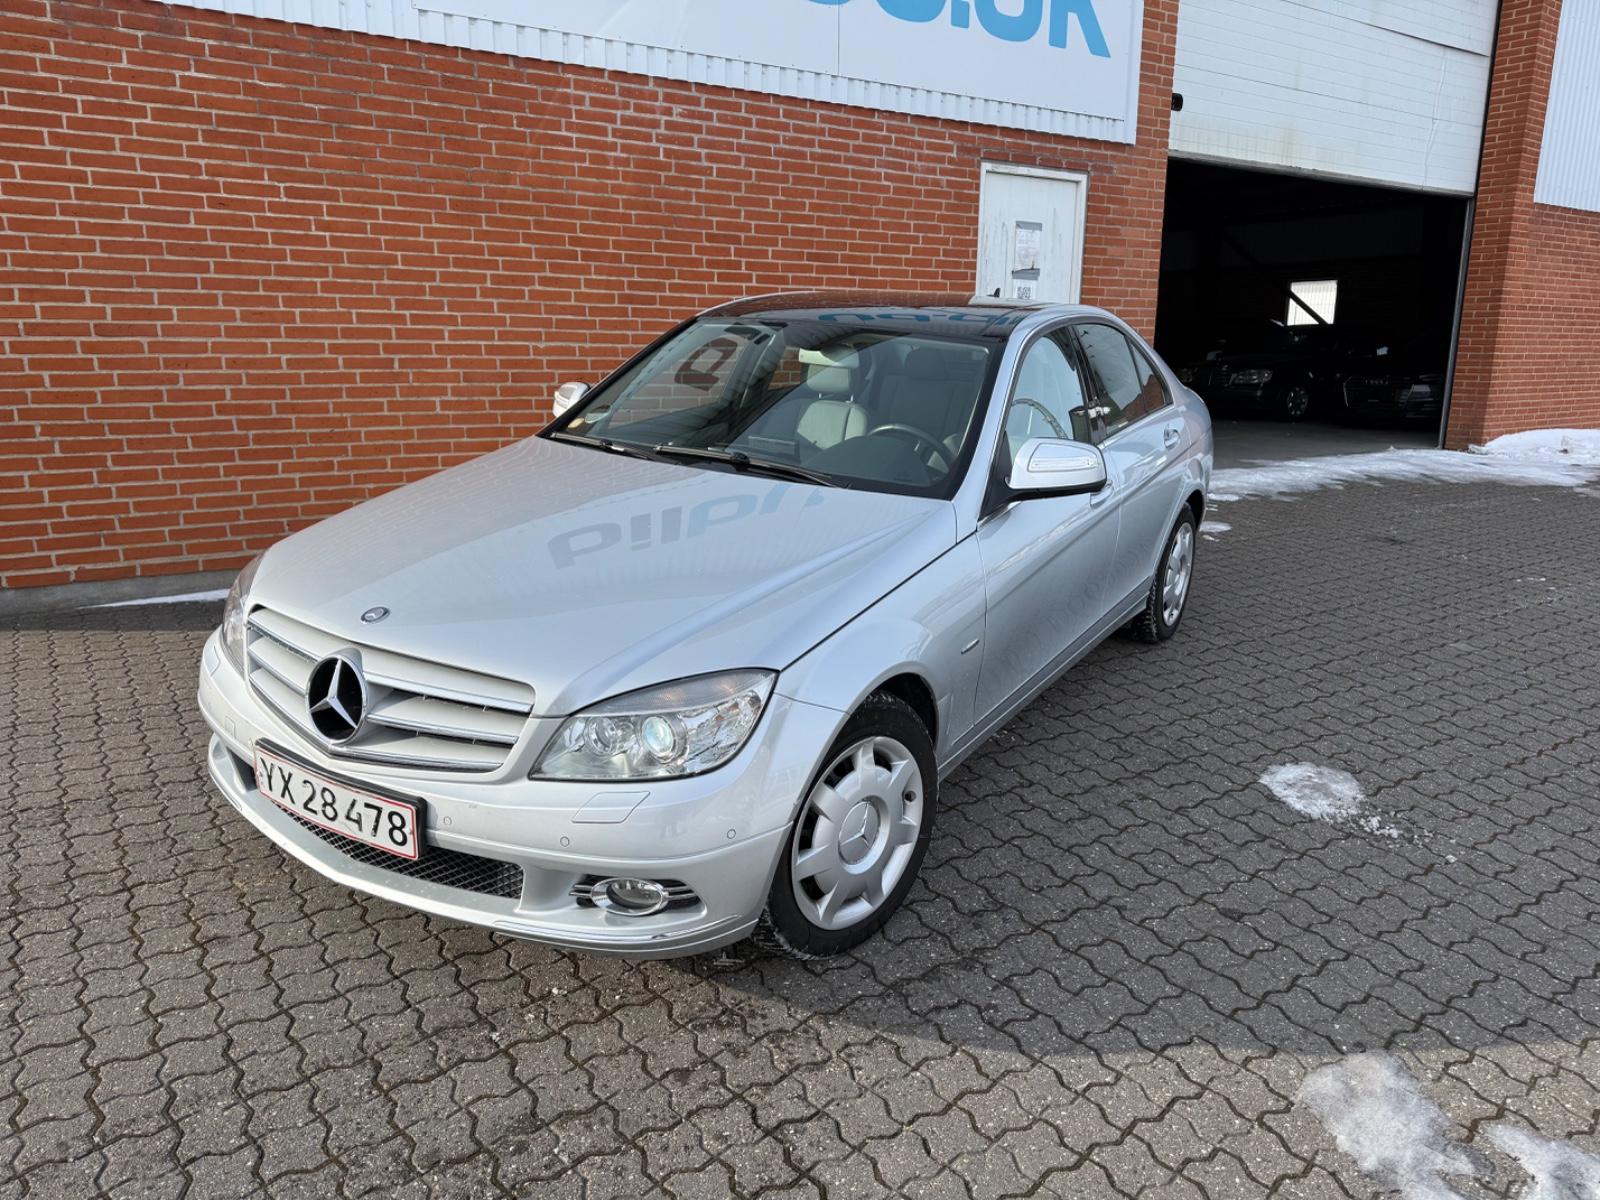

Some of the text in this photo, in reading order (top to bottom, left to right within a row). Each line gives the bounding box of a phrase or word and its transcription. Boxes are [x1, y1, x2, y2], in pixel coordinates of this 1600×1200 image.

[260, 757, 408, 847] YX 28 478
